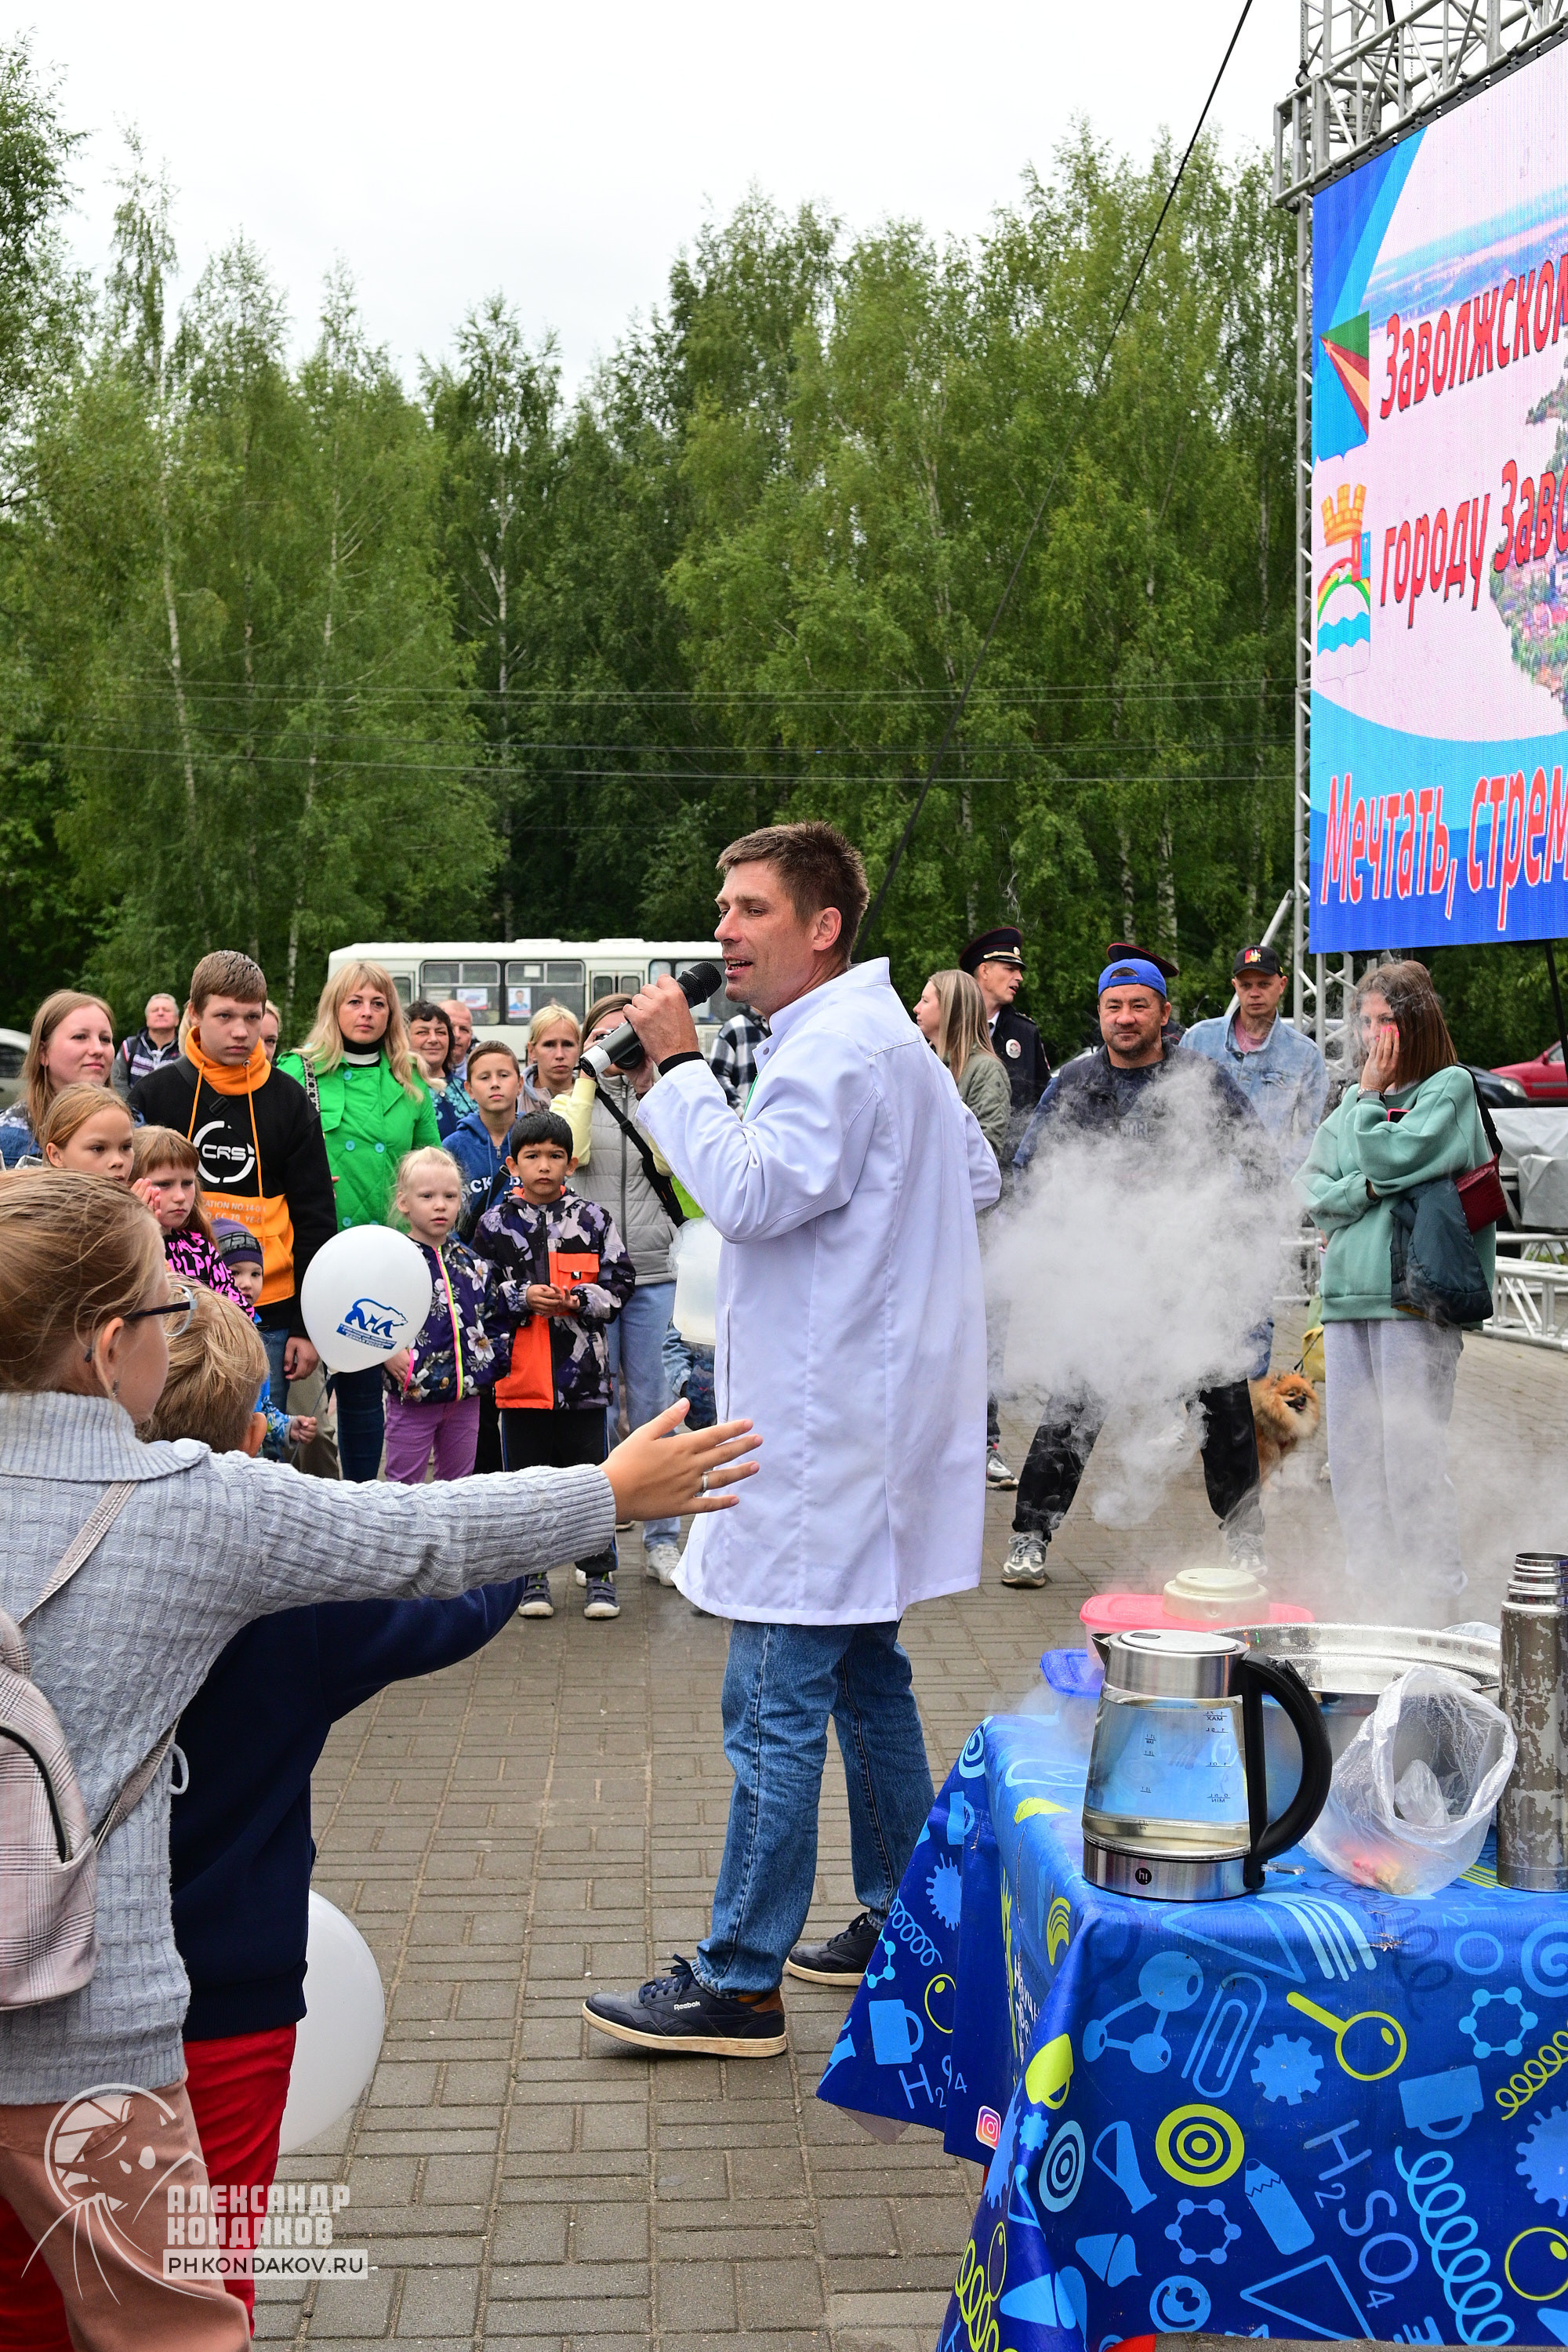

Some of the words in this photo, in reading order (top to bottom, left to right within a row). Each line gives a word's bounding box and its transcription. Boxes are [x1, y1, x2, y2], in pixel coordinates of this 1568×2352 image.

[1381, 492, 1490, 630] городу
[1320, 772, 1457, 920] Мечтать,
[201, 1143, 247, 1161] CRS
[673, 2000, 701, 2011] Reebok
